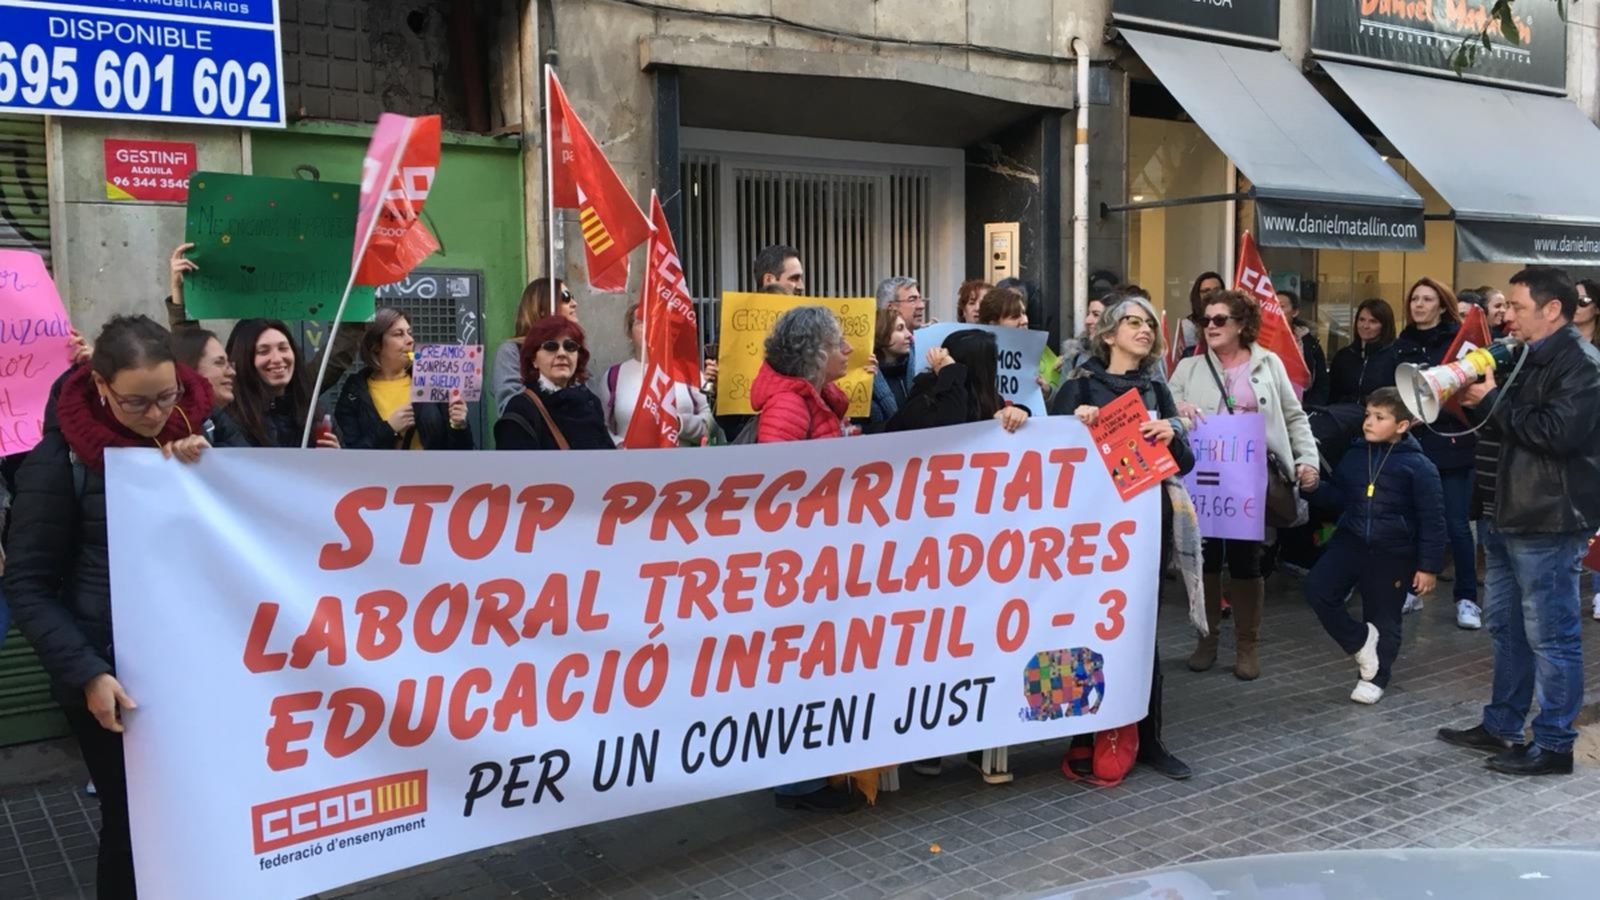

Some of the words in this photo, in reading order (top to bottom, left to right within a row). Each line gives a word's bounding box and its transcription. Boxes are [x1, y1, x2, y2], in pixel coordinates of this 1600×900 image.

[49, 16, 213, 50] DISPONIBLE
[0, 41, 79, 107] 695
[94, 49, 174, 112] 601
[192, 57, 271, 118] 602
[116, 149, 188, 165] GESTINFI
[131, 166, 173, 175] ALQUILA
[113, 176, 130, 187] 96
[132, 177, 157, 188] 344
[1263, 212, 1418, 237] www.danielmatallin.com
[420, 344, 466, 359] CREAMOS
[416, 360, 459, 374] SONRISAS
[413, 375, 426, 387] UN
[430, 375, 460, 389] SUELDO
[1102, 443, 1112, 454] 8
[318, 483, 575, 570] STOP
[597, 447, 1088, 546] PRECARIETAT
[243, 570, 609, 675] LABORAL
[640, 520, 1137, 624] TREBALLADORES
[265, 623, 669, 772] EDUCACIÓ
[691, 604, 974, 698] INFANTIL
[1051, 613, 1076, 628] -
[1095, 589, 1128, 641] 3
[463, 749, 571, 817] PER
[591, 729, 660, 793] UN
[680, 692, 876, 774] CONVENI
[893, 677, 996, 736] JUST
[261, 789, 374, 843] CCOO
[259, 842, 323, 871] federació
[326, 817, 426, 852] d'ensenyament
